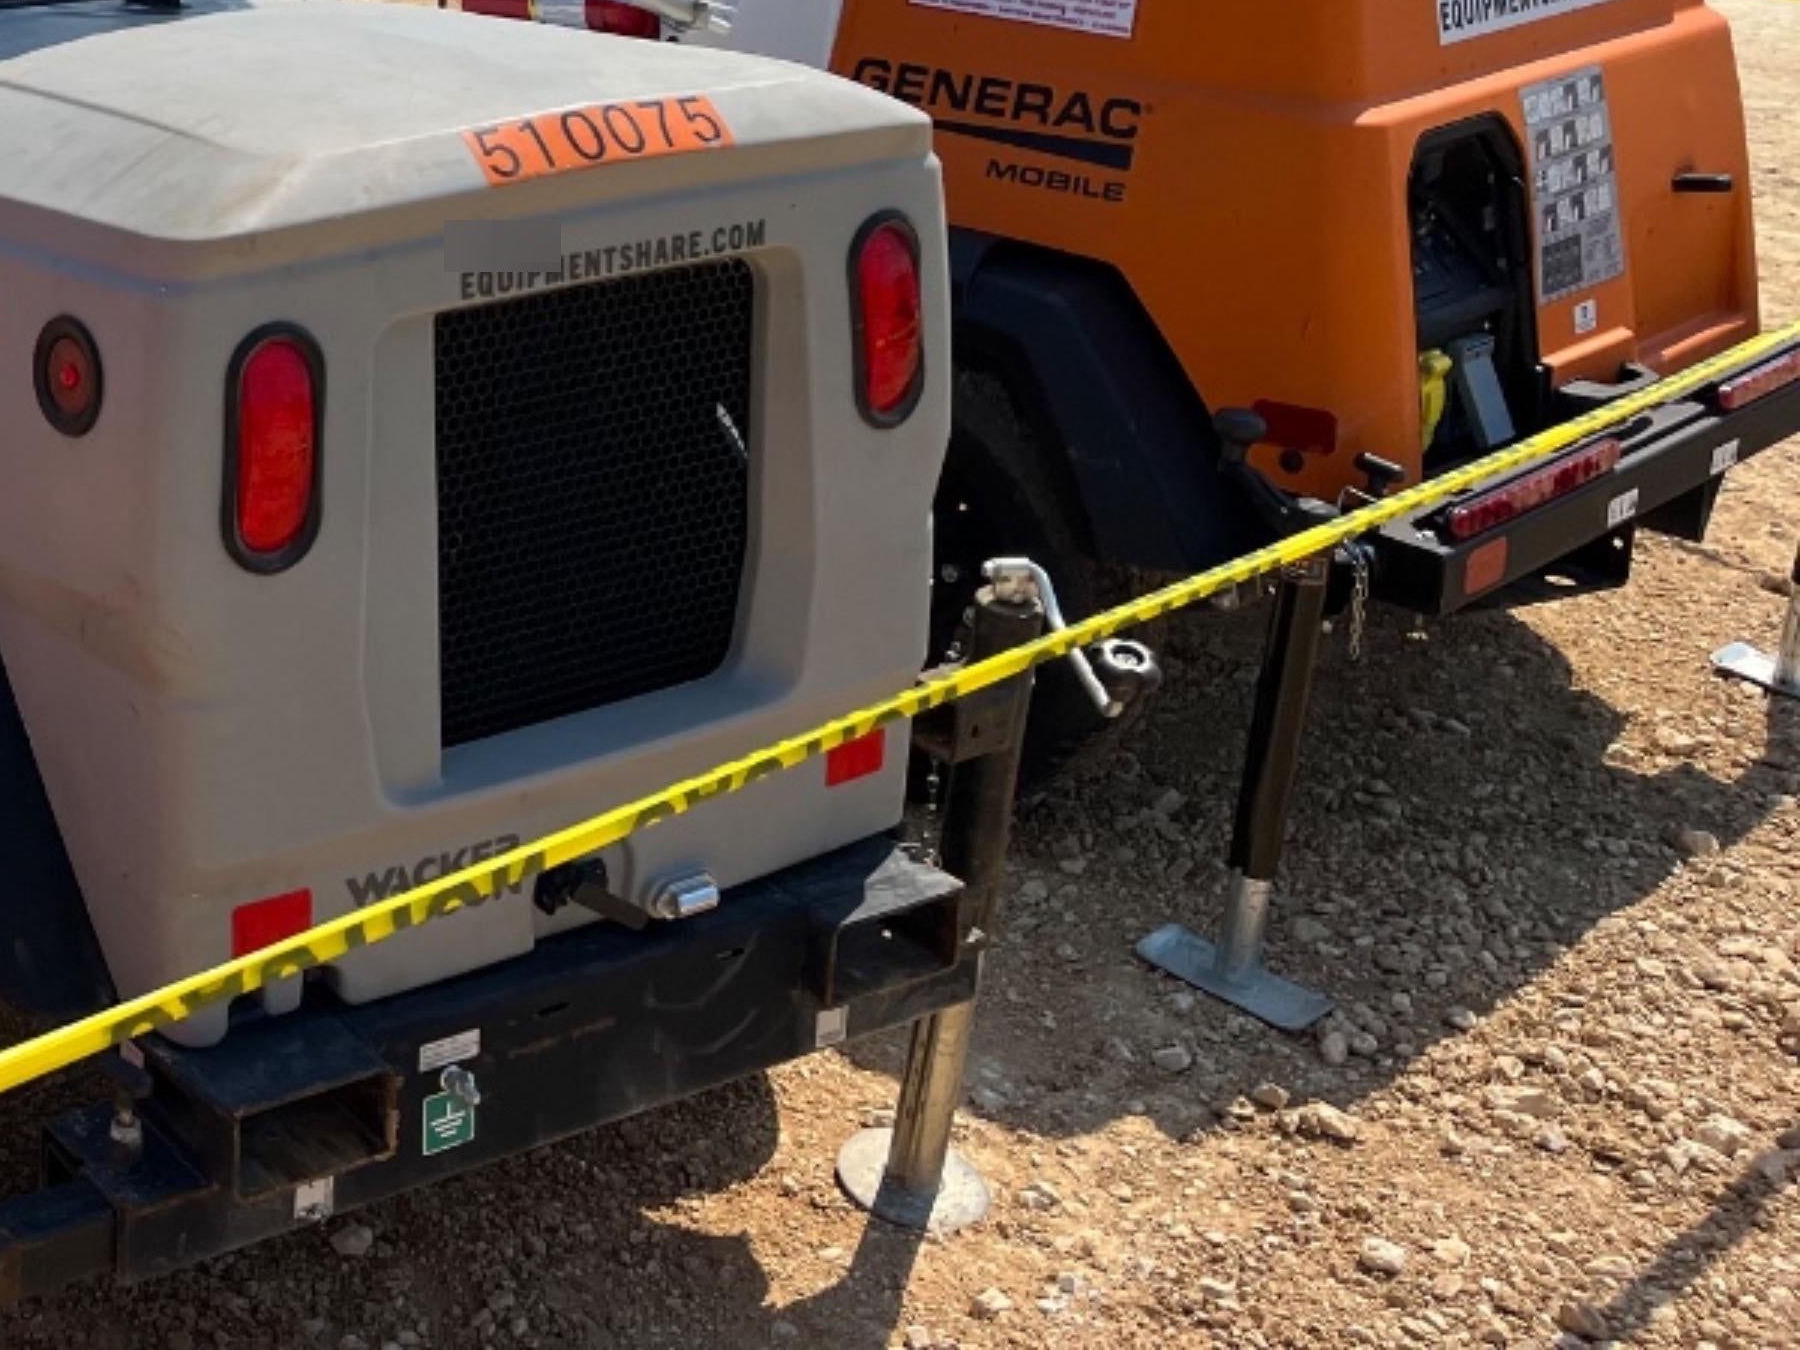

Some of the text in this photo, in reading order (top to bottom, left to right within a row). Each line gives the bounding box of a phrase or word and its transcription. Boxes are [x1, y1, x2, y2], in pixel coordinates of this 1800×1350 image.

[475, 96, 722, 178] 510075
[853, 58, 1142, 140] GENERAC
[986, 159, 1125, 202] MOBILE
